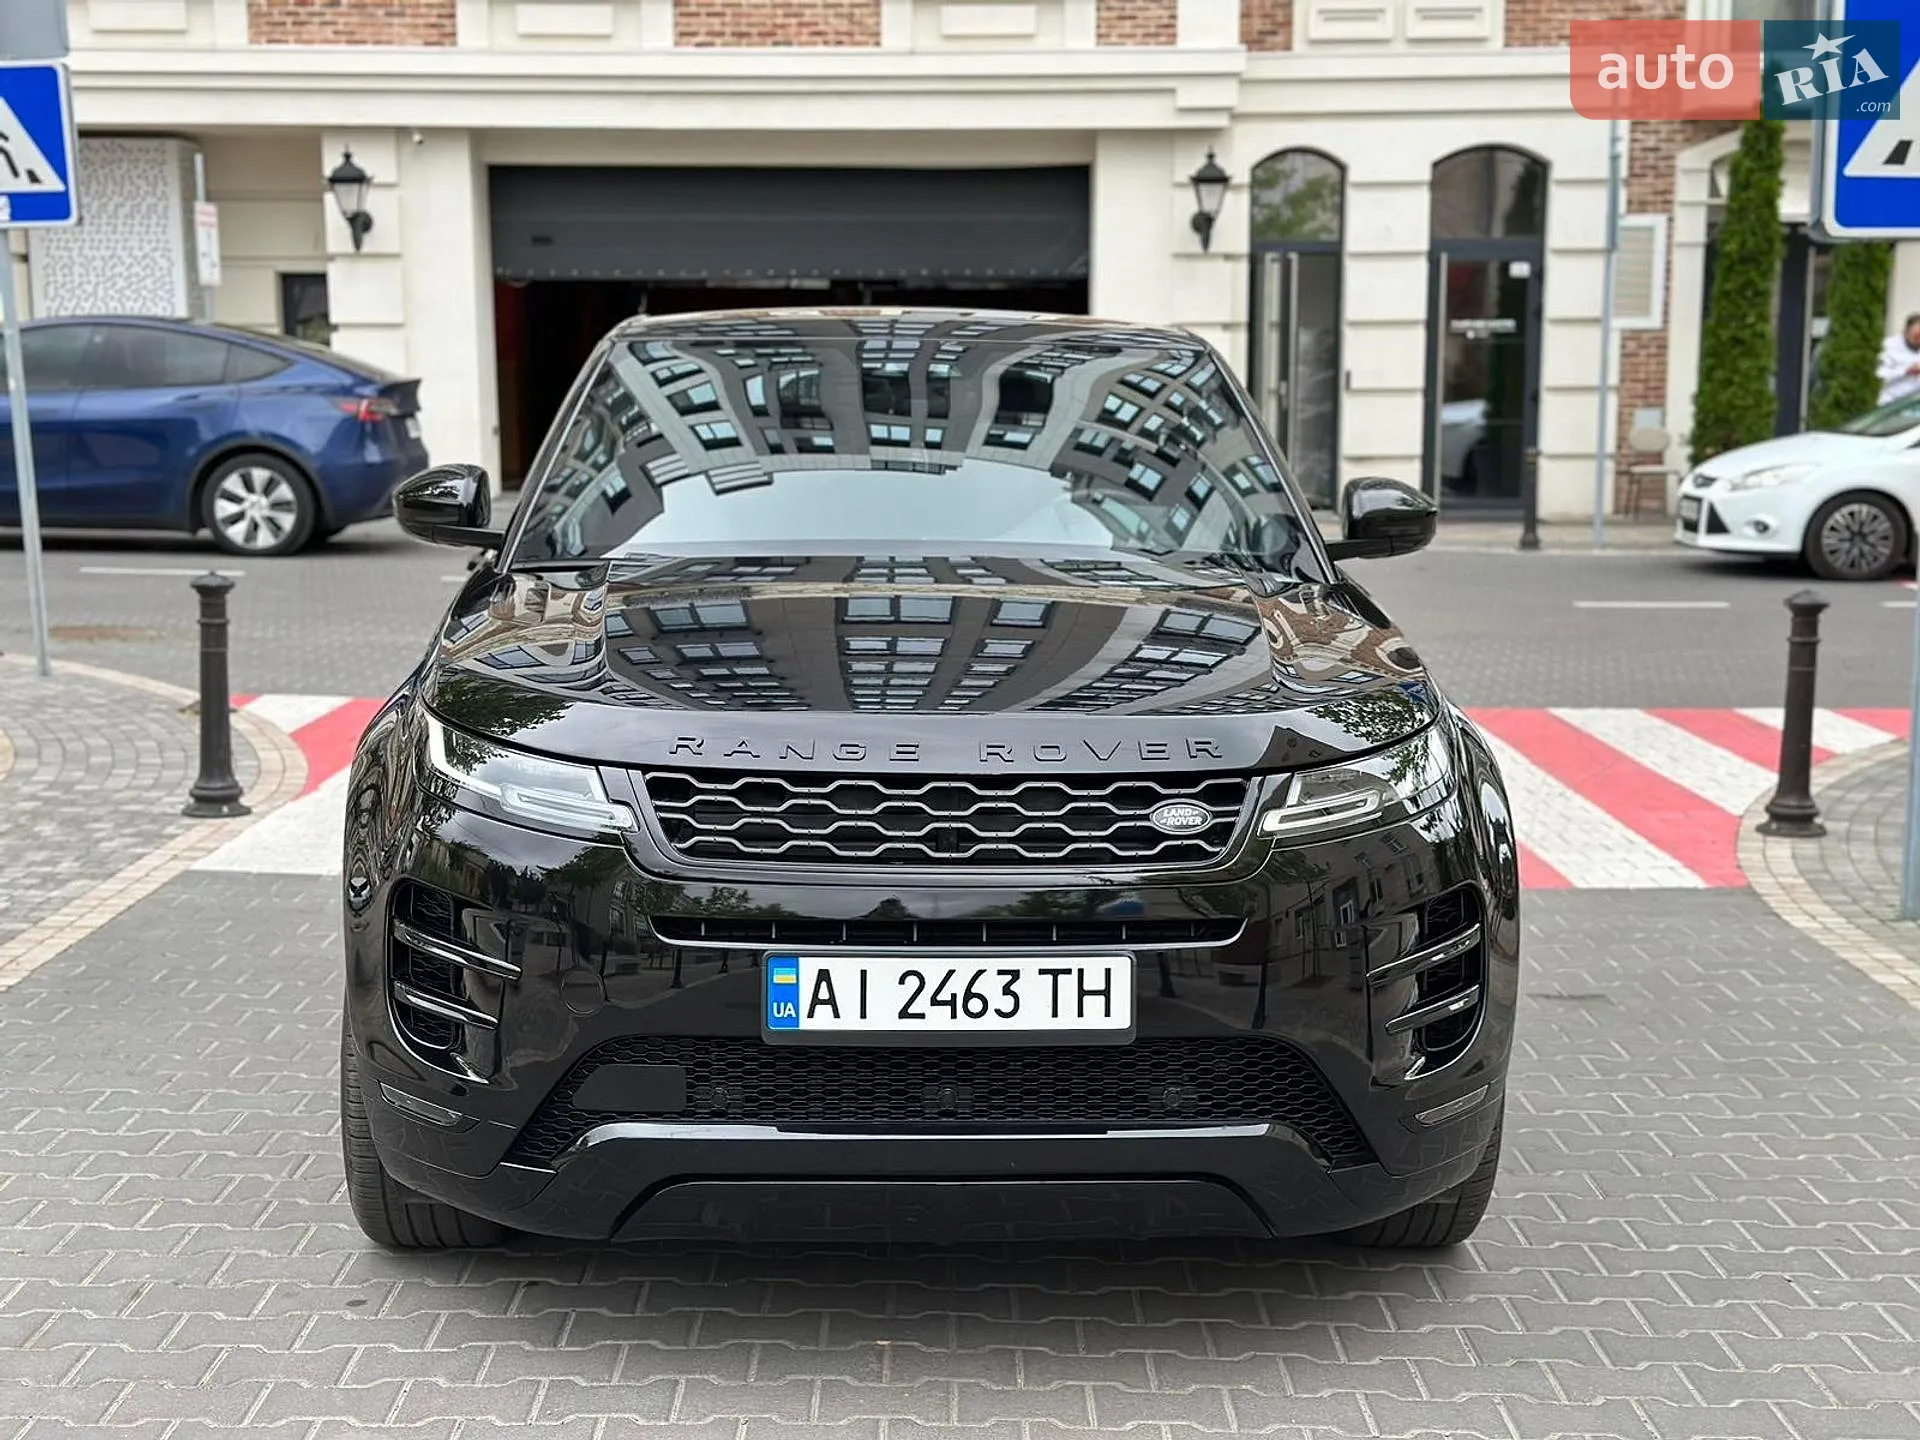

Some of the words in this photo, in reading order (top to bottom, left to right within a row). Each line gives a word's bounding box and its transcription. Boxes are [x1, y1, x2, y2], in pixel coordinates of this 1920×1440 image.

[669, 736, 920, 762] RANGE
[979, 736, 1223, 763] ROVER
[1163, 807, 1192, 817] LAND
[1166, 816, 1203, 826] ROVER
[806, 968, 868, 1019] AI
[897, 968, 1021, 1019] 2463
[1038, 967, 1112, 1018] TH
[772, 1002, 797, 1018] UA
